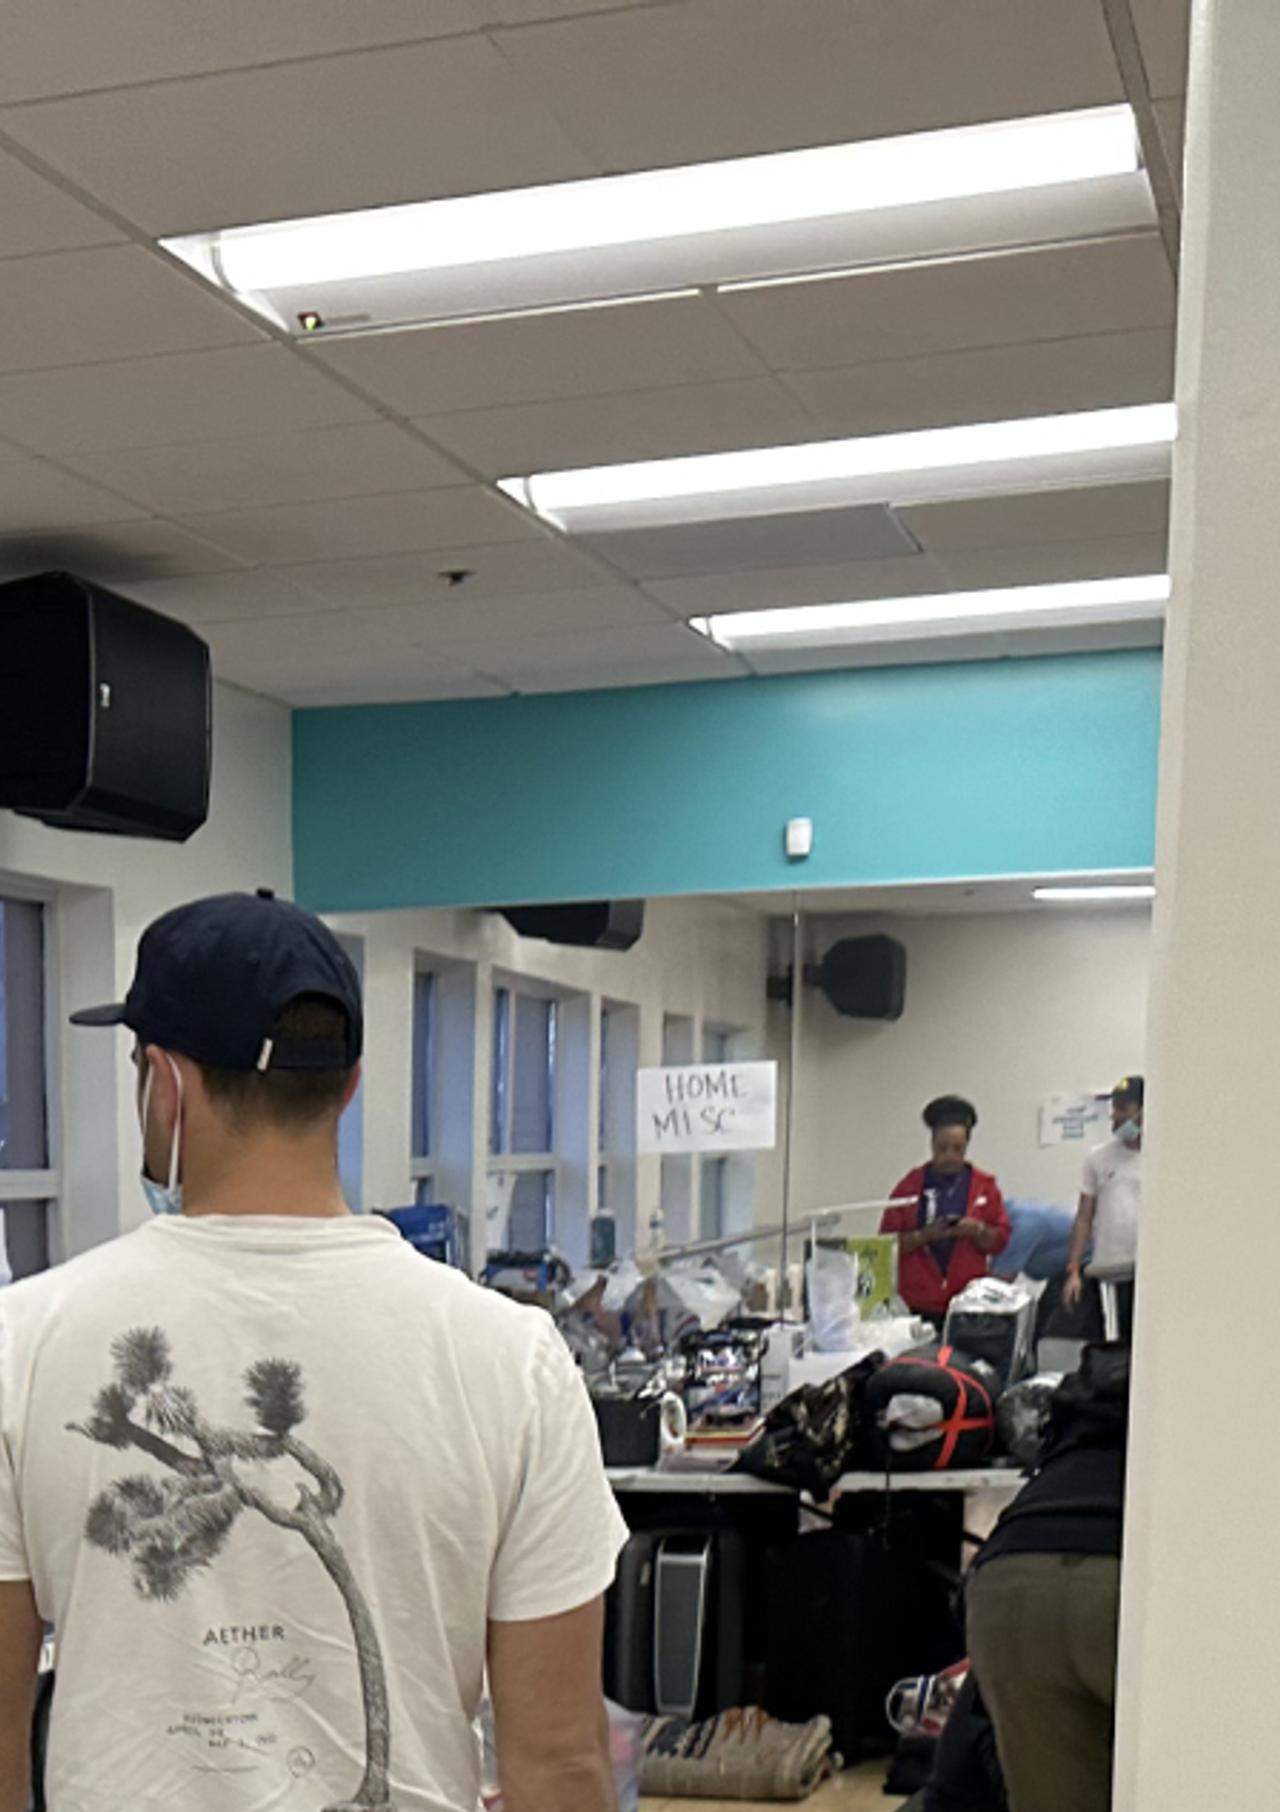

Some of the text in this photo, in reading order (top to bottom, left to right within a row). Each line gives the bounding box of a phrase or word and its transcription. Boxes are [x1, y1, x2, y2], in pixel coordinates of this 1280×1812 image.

[664, 1070, 747, 1103] HOME
[652, 1106, 736, 1140] MISC
[202, 1625, 286, 1646] AETHER
